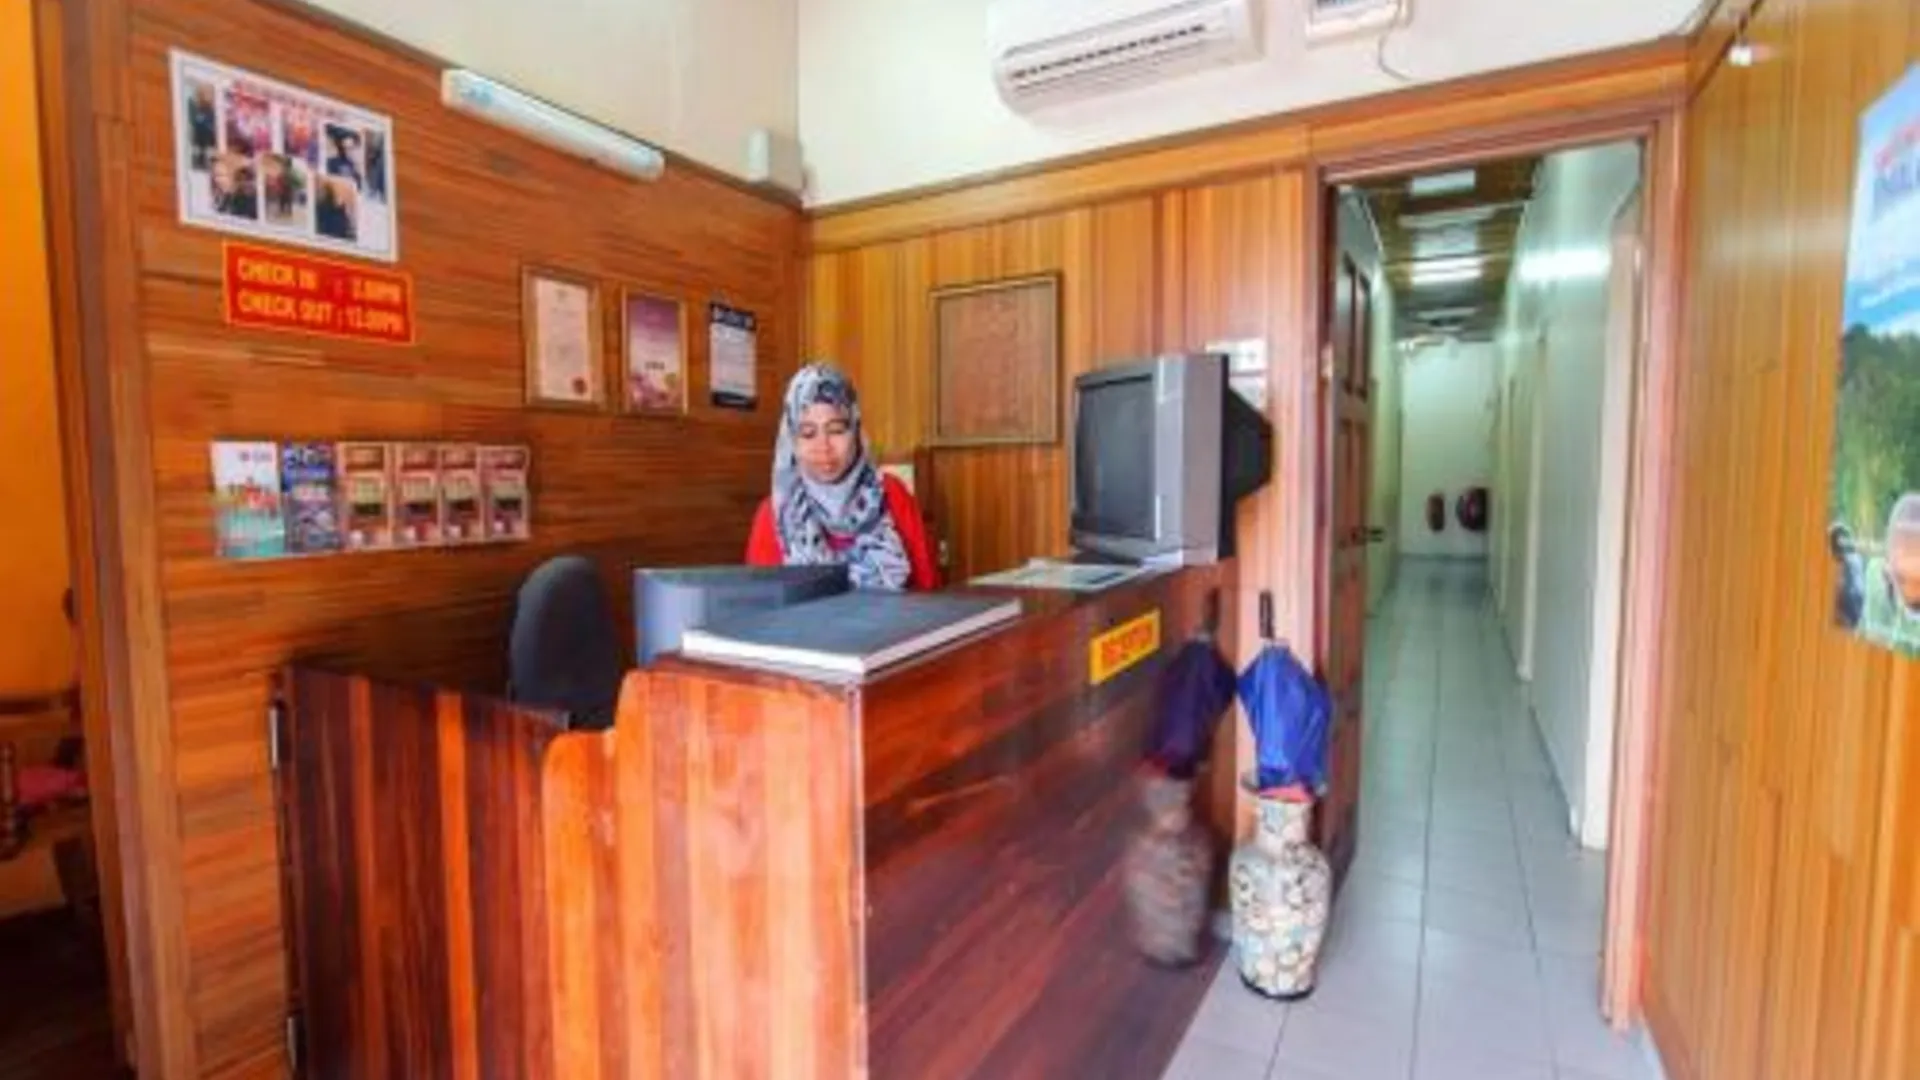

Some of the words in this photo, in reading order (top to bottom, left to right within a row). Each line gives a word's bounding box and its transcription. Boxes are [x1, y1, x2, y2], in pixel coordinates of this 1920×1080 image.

[237, 256, 296, 288] CHECK
[299, 268, 318, 292] IN
[237, 288, 297, 320] CHECK
[299, 298, 335, 326] OUT
